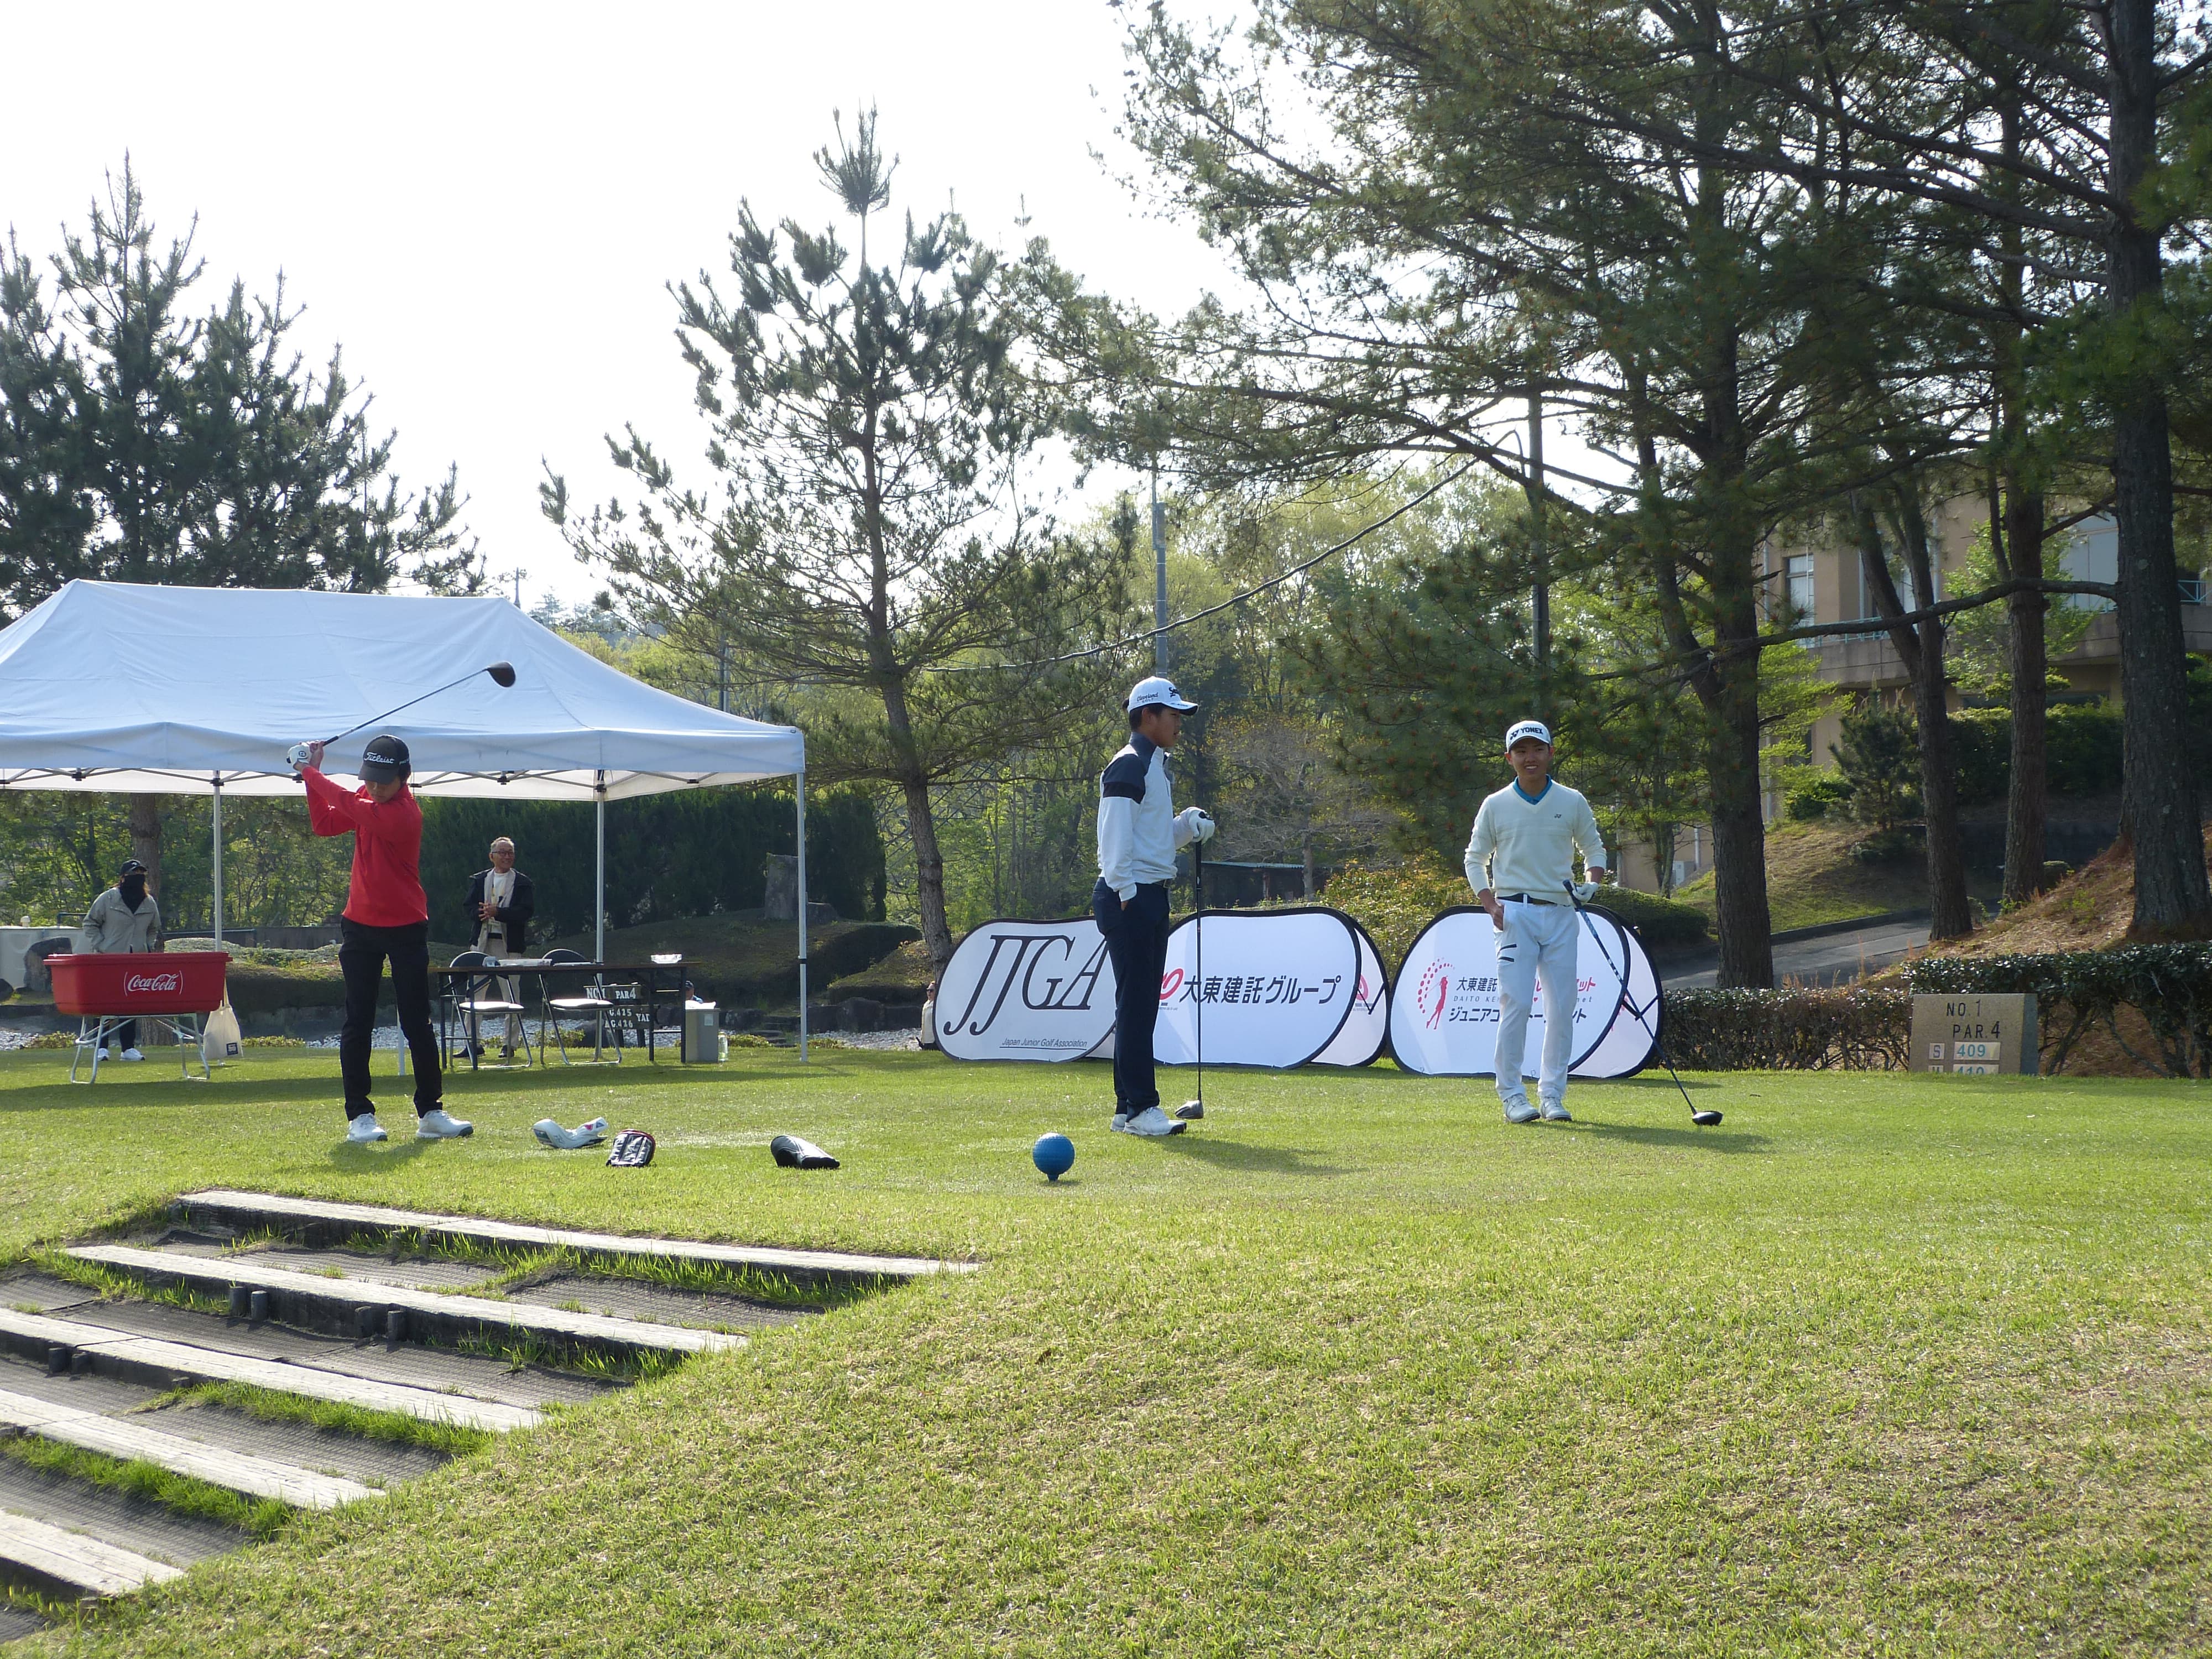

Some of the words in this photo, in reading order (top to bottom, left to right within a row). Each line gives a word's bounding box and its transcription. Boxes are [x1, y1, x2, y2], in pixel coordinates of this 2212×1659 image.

[1136, 692, 1159, 702] Cleveland
[1521, 727, 1543, 735] YONEX
[364, 752, 395, 764] Titleist
[127, 973, 179, 992] Coca-Cola
[943, 935, 1106, 1036] JJGA
[1179, 975, 1342, 1004] 大東建託グループ
[1002, 1037, 1021, 1047] Japan
[1021, 1038, 1040, 1046] Junior
[1040, 1039, 1055, 1047] Golf
[1054, 1039, 1088, 1047] Association
[1932, 1044, 1940, 1058] S
[1957, 1044, 1986, 1057] 409
